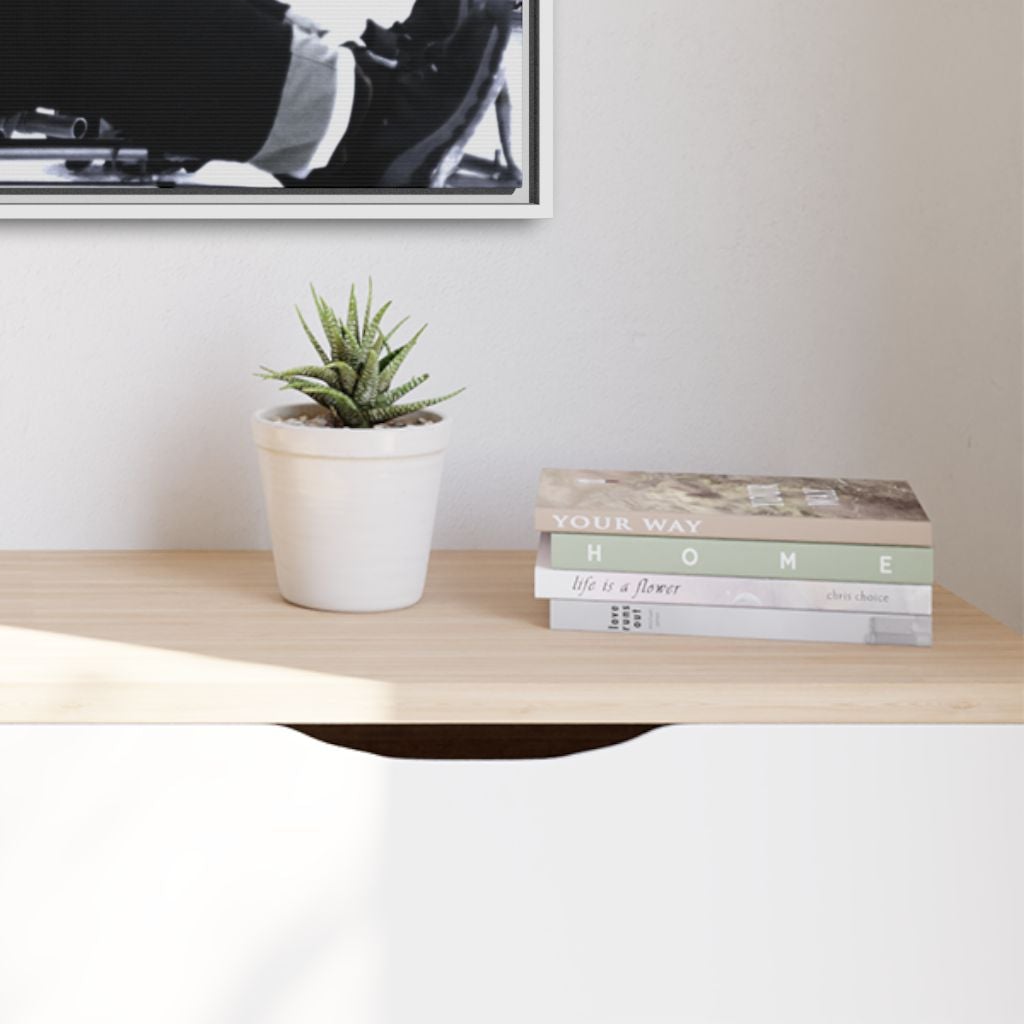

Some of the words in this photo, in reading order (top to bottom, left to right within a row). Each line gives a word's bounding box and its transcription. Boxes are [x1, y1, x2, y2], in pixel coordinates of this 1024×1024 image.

[552, 514, 633, 531] YOUR
[642, 517, 702, 533] WAY
[572, 575, 596, 596] life
[602, 578, 615, 592] is
[620, 582, 628, 593] a
[632, 578, 682, 599] flower
[827, 589, 852, 601] chris
[855, 590, 889, 603] choice
[608, 605, 620, 630] love
[622, 605, 631, 631] runs
[632, 609, 642, 628] out
